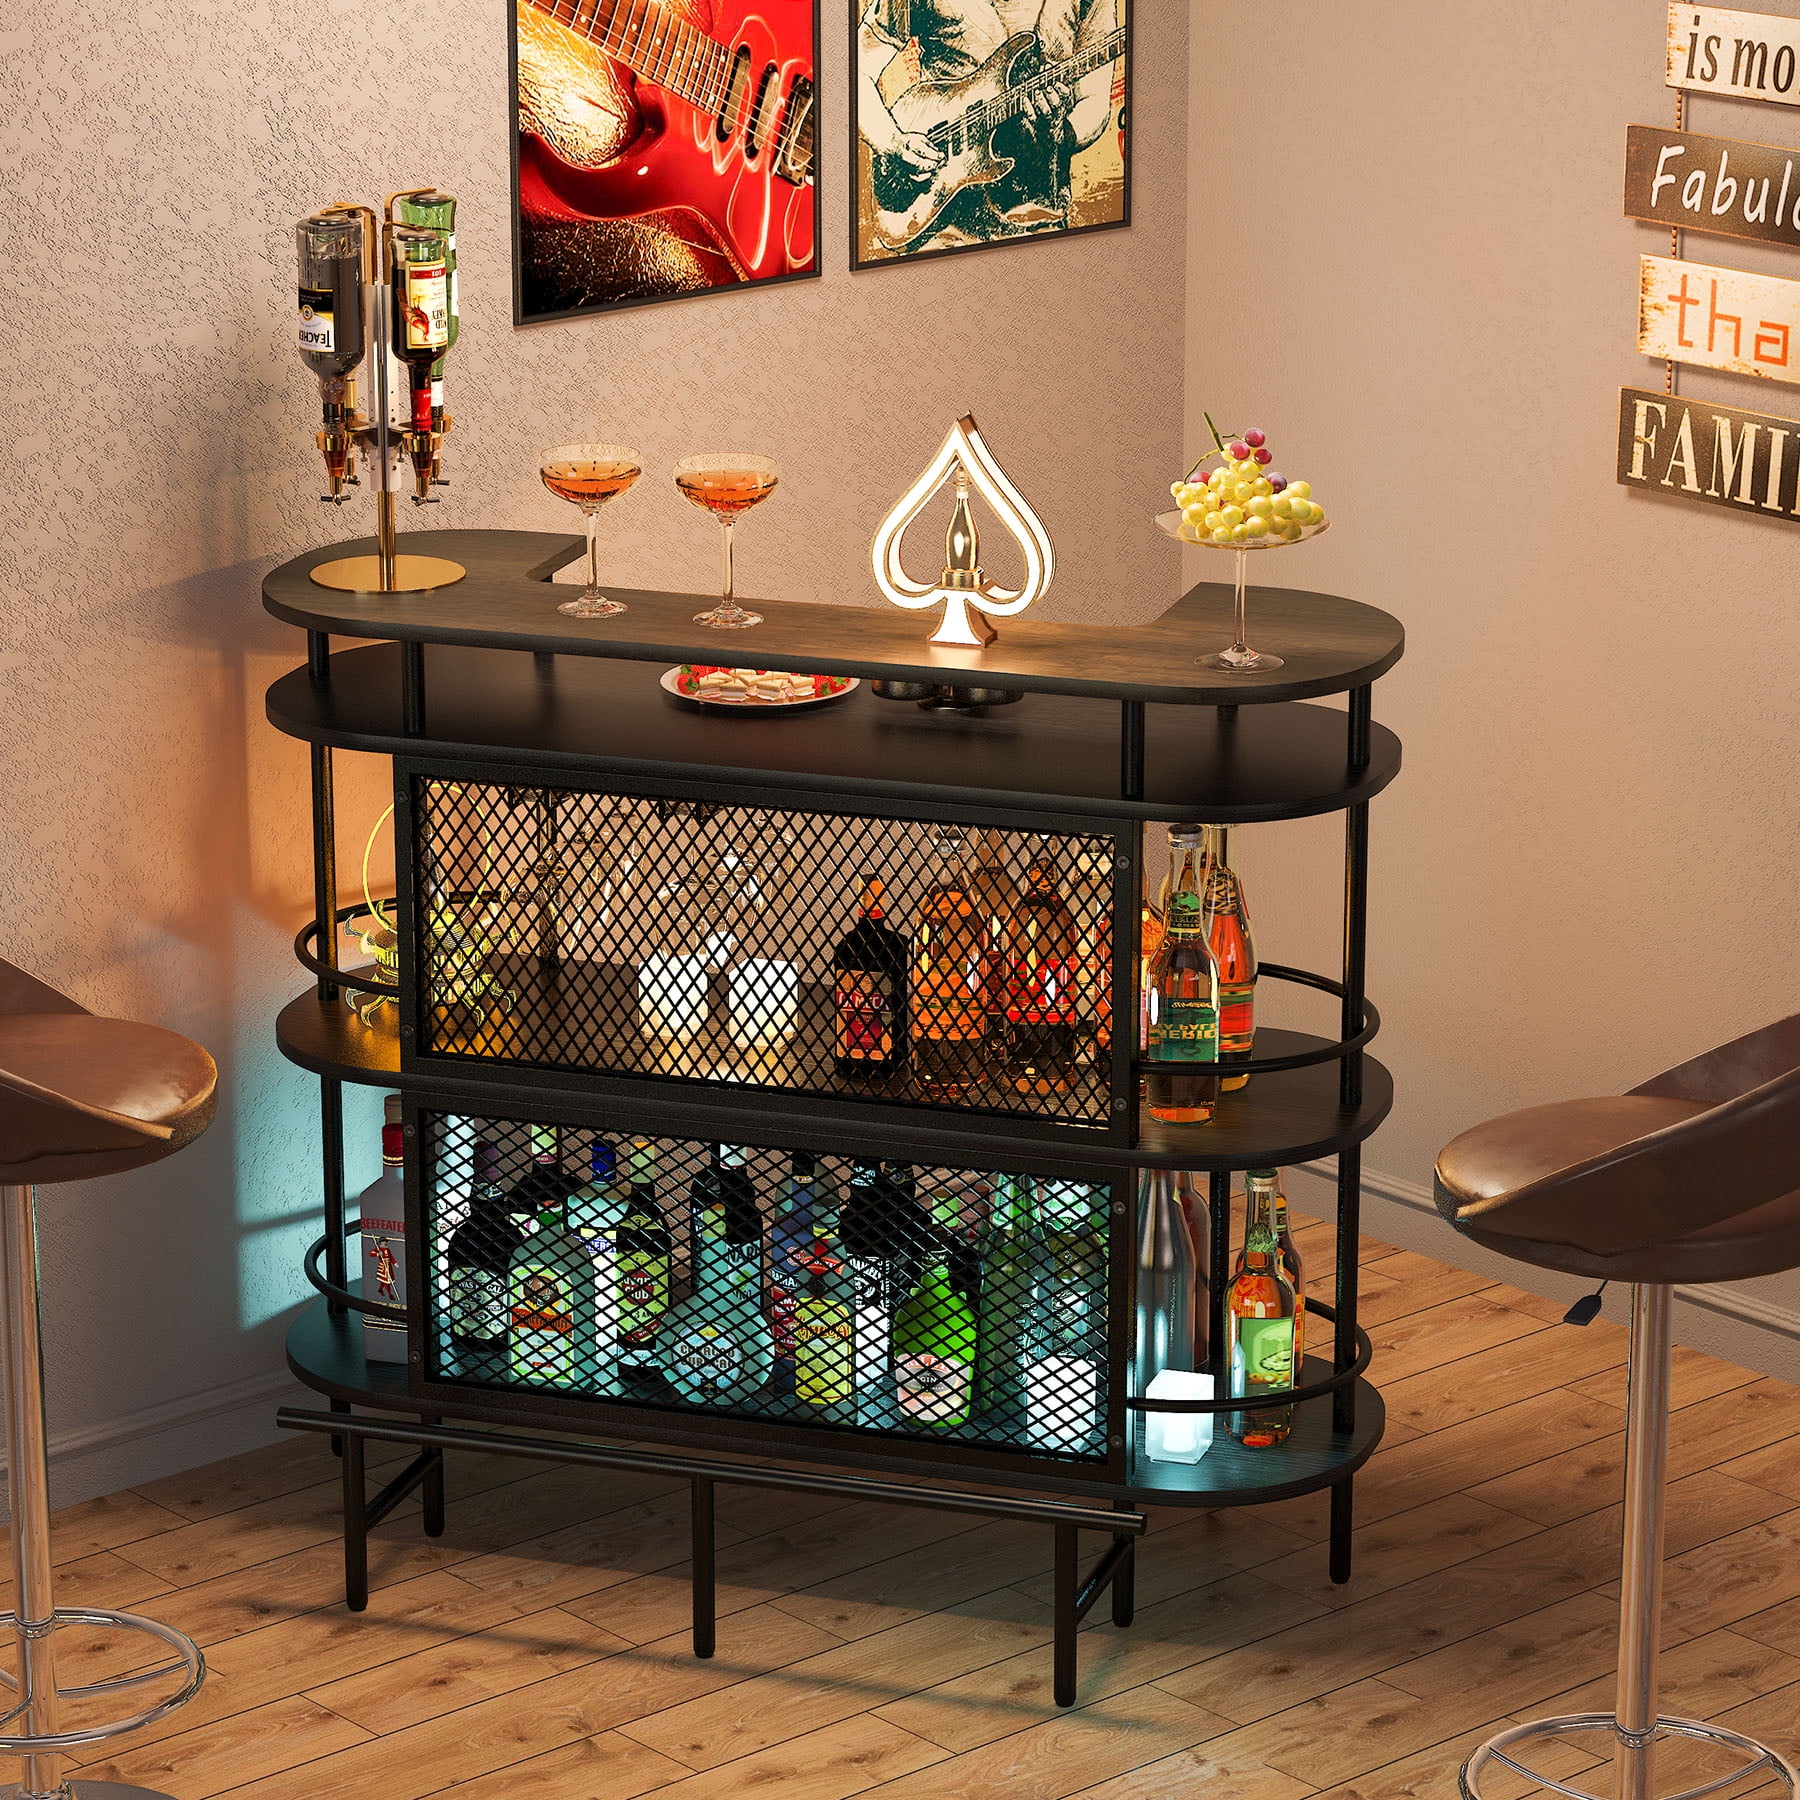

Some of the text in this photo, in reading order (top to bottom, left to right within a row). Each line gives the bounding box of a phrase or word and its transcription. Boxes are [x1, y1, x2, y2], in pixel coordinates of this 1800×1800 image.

[1686, 15, 1800, 95] is mo
[1626, 399, 1800, 516] FAMI
[360, 1216, 405, 1233] BEEFEATE
